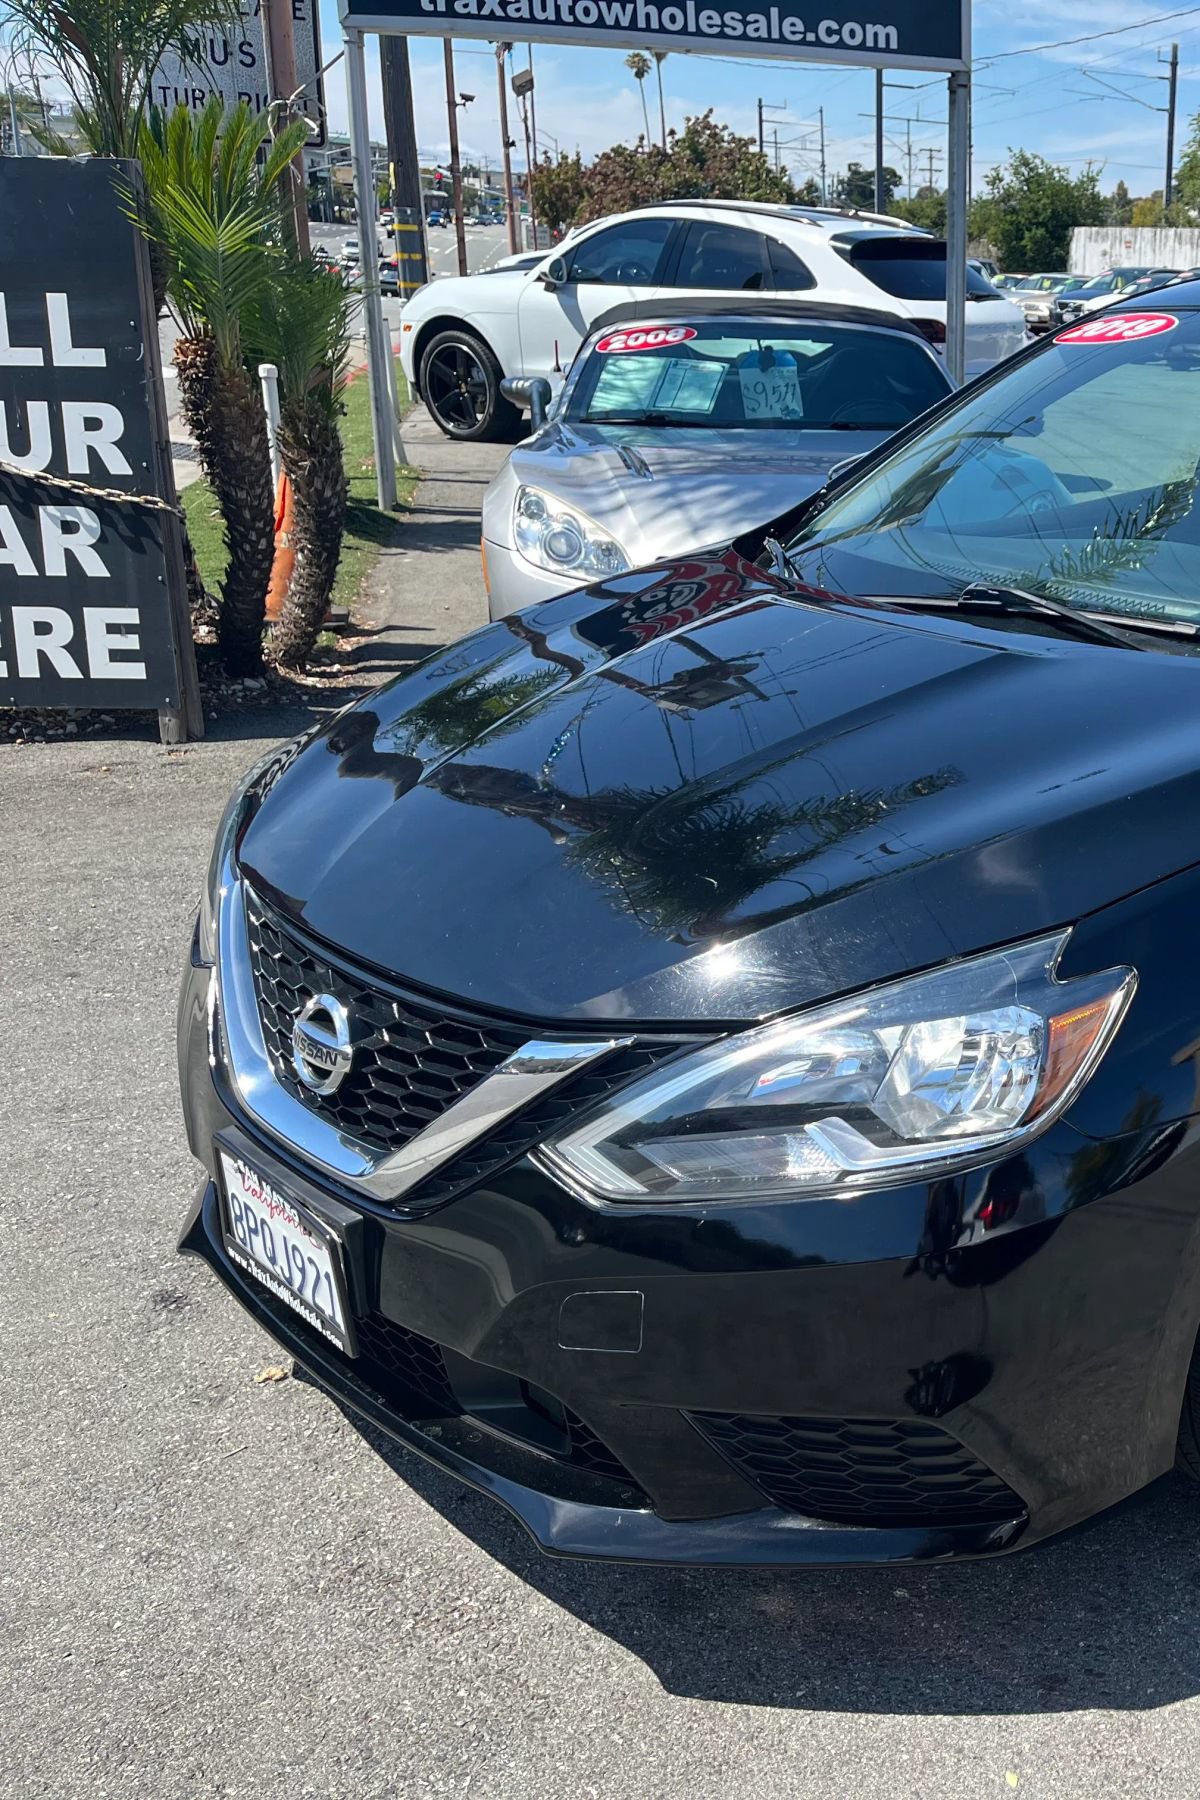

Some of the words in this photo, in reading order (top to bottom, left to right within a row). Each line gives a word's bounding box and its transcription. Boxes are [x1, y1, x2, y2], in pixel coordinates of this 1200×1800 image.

[609, 328, 687, 349] 2008
[294, 1033, 338, 1066] NISSAN
[231, 1193, 336, 1324] 8PQJ921
